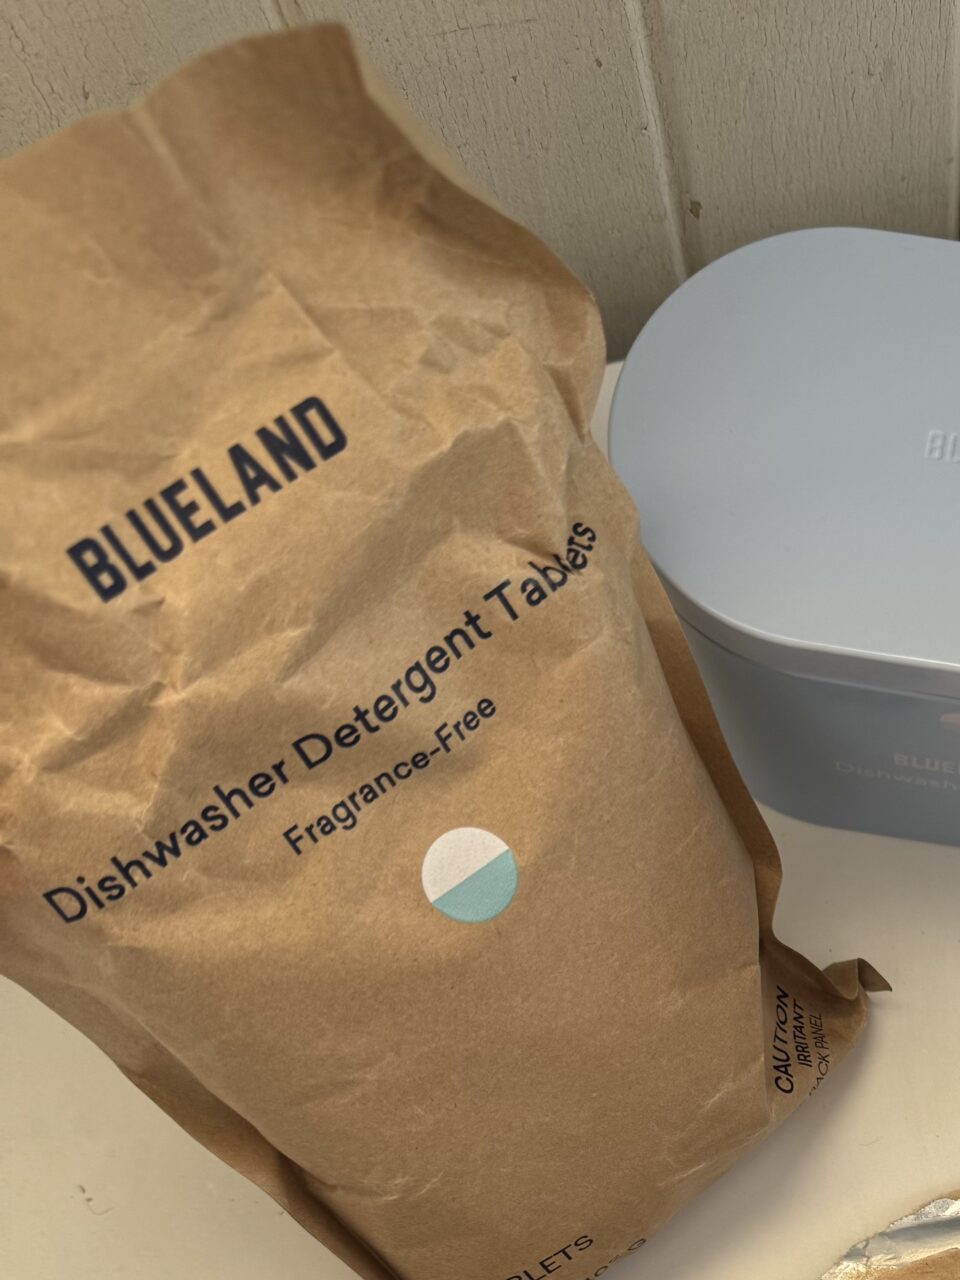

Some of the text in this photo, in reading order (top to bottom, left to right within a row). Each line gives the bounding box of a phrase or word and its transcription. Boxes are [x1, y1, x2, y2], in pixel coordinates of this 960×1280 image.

[67, 396, 348, 603] BLUELAND
[43, 522, 596, 924] Dishwasher Detergent Tablets
[283, 697, 497, 855] Fragrance-Free
[773, 985, 793, 1094] CAUTION
[793, 998, 813, 1067] IRRITANT
[810, 1014, 829, 1049] PANEL
